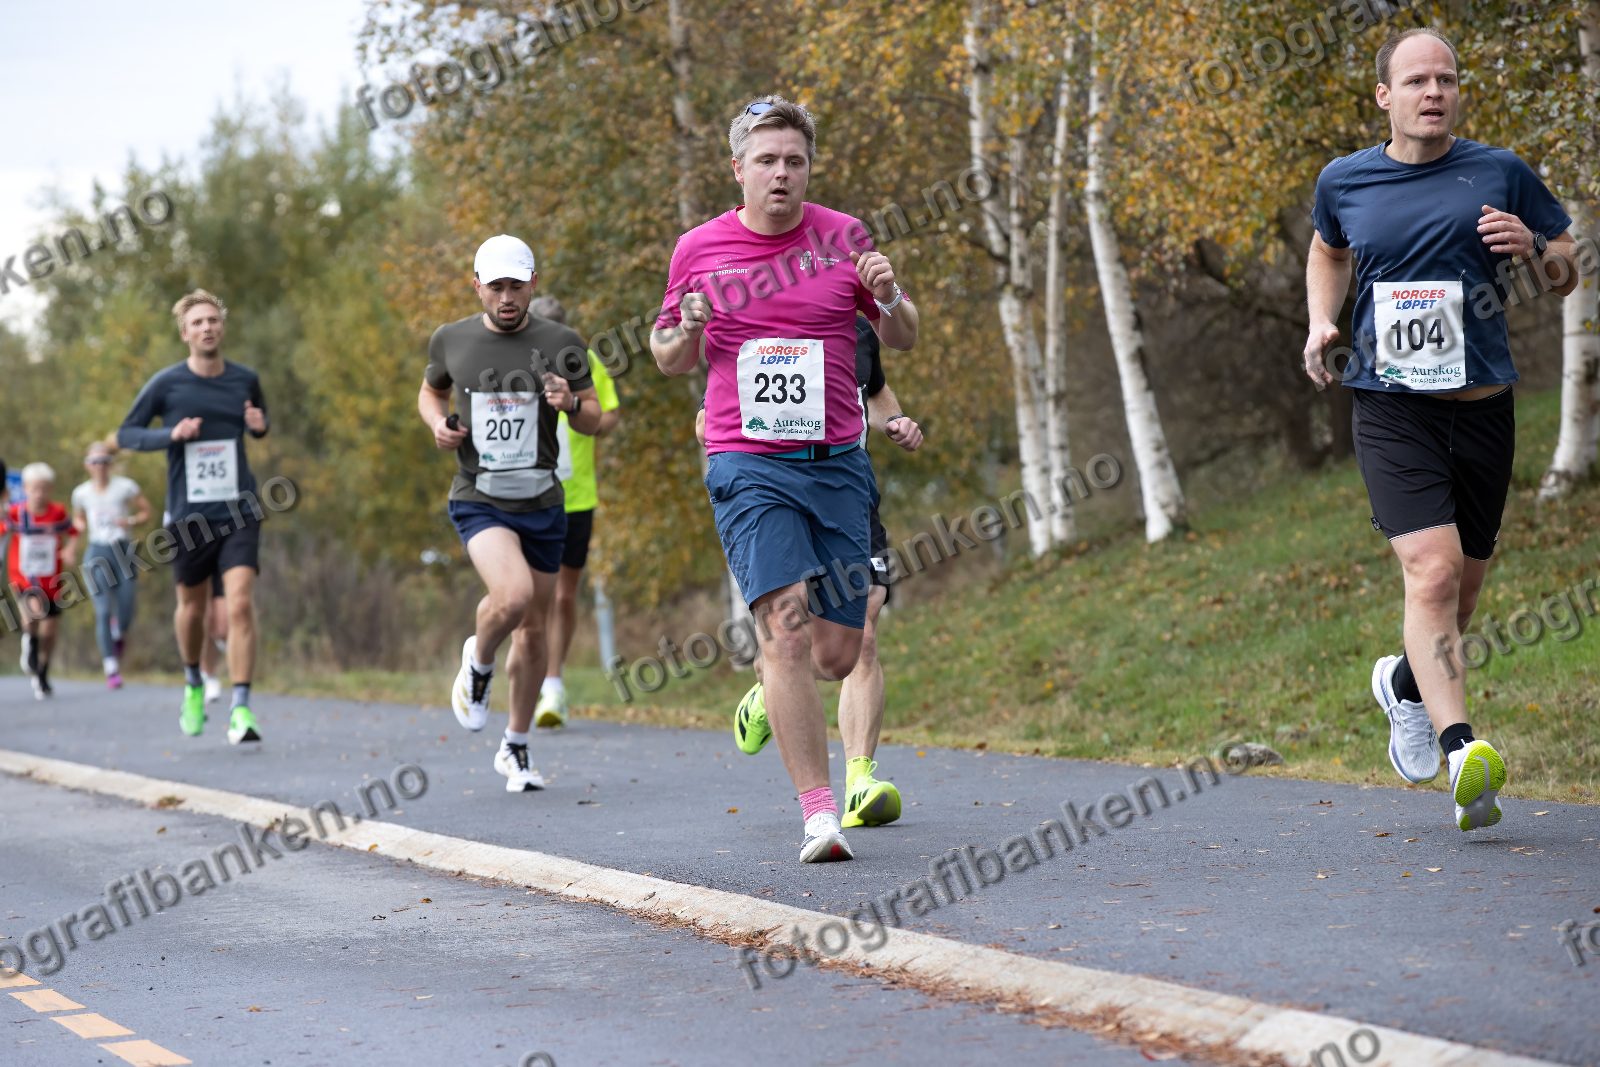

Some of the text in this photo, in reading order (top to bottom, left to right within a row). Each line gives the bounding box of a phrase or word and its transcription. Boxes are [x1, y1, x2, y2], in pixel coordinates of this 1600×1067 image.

[1391, 289, 1446, 299] NORGES
[1396, 299, 1437, 310] LØPET
[1390, 318, 1445, 351] 104
[756, 345, 809, 355] NORGES
[760, 355, 800, 365] LØPET
[1410, 364, 1461, 377] Aurskog
[754, 372, 806, 404] 233
[486, 418, 525, 441] 207
[773, 417, 822, 431] Aurskog
[197, 461, 227, 479] 245
